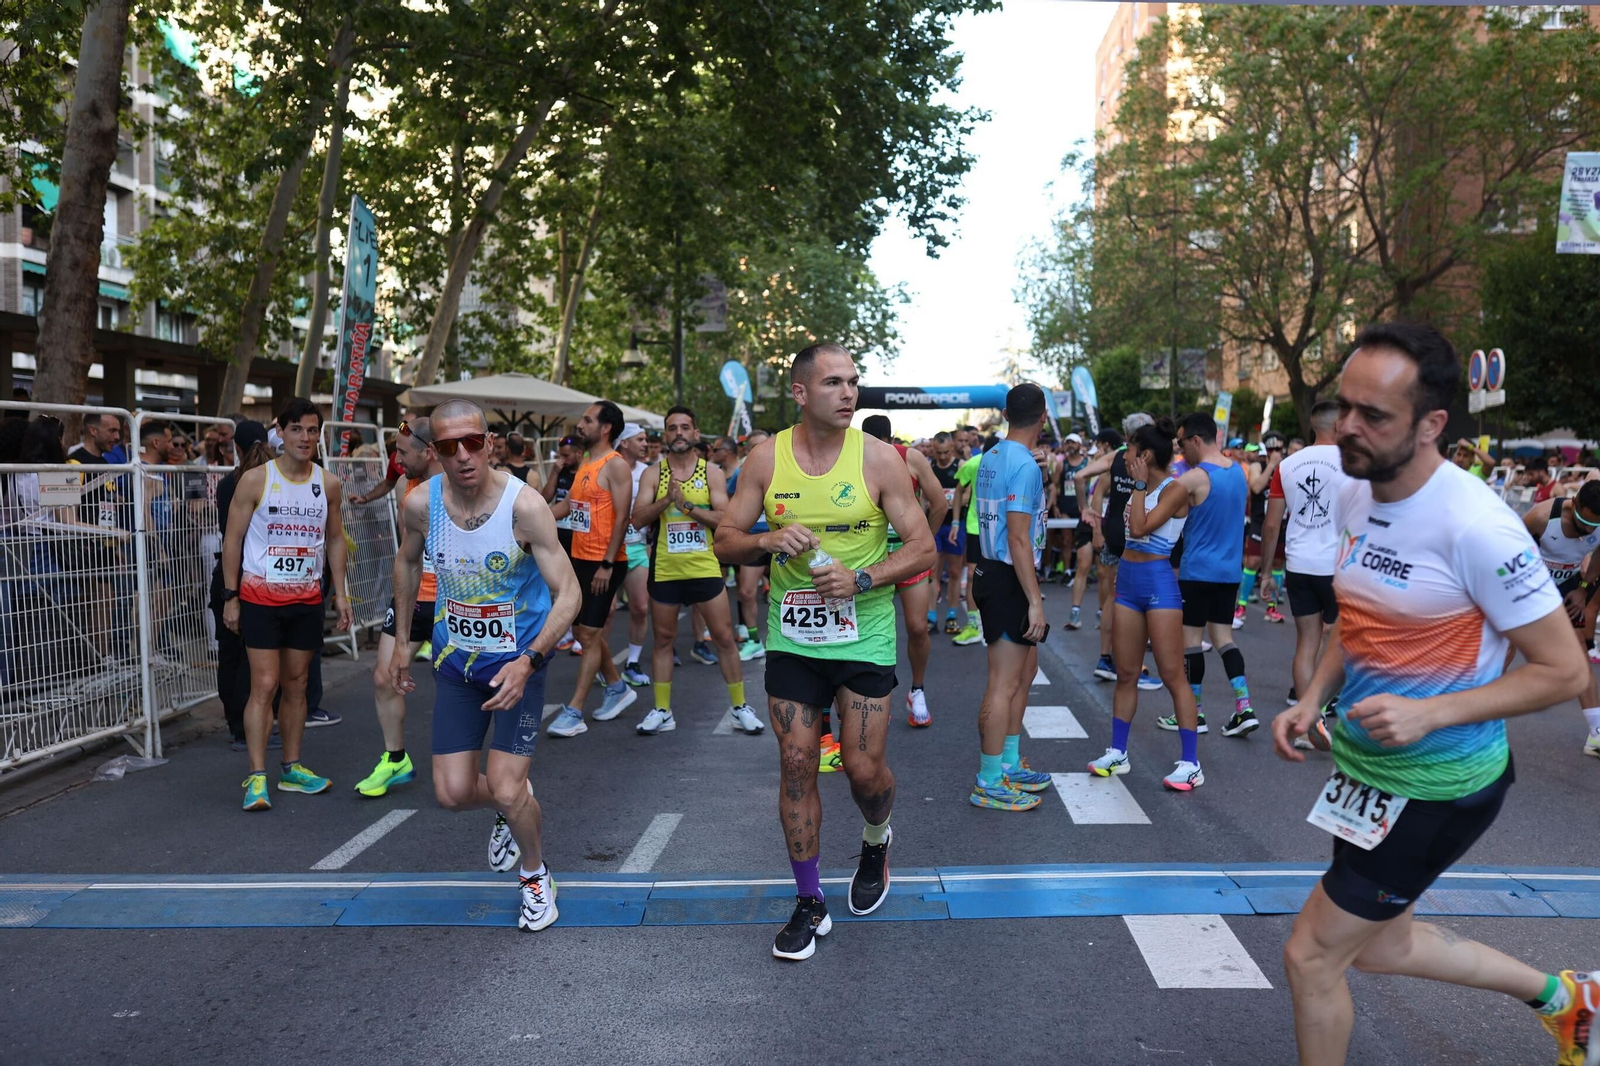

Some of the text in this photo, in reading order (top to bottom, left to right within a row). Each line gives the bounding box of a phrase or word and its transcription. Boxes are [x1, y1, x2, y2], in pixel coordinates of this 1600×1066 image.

[363, 253, 371, 288] 1
[884, 392, 971, 404] POWERADE
[267, 523, 321, 534] GRANADA
[267, 530, 320, 540] RUNNERS
[668, 531, 701, 545] 3096
[274, 558, 305, 572] 497
[1362, 551, 1414, 580] CORRE
[785, 593, 797, 604] 41
[448, 601, 456, 613] 41
[782, 607, 840, 627] 4251
[448, 615, 503, 639] 5690
[851, 701, 883, 712] JUANA
[1325, 771, 1394, 823] 3715
